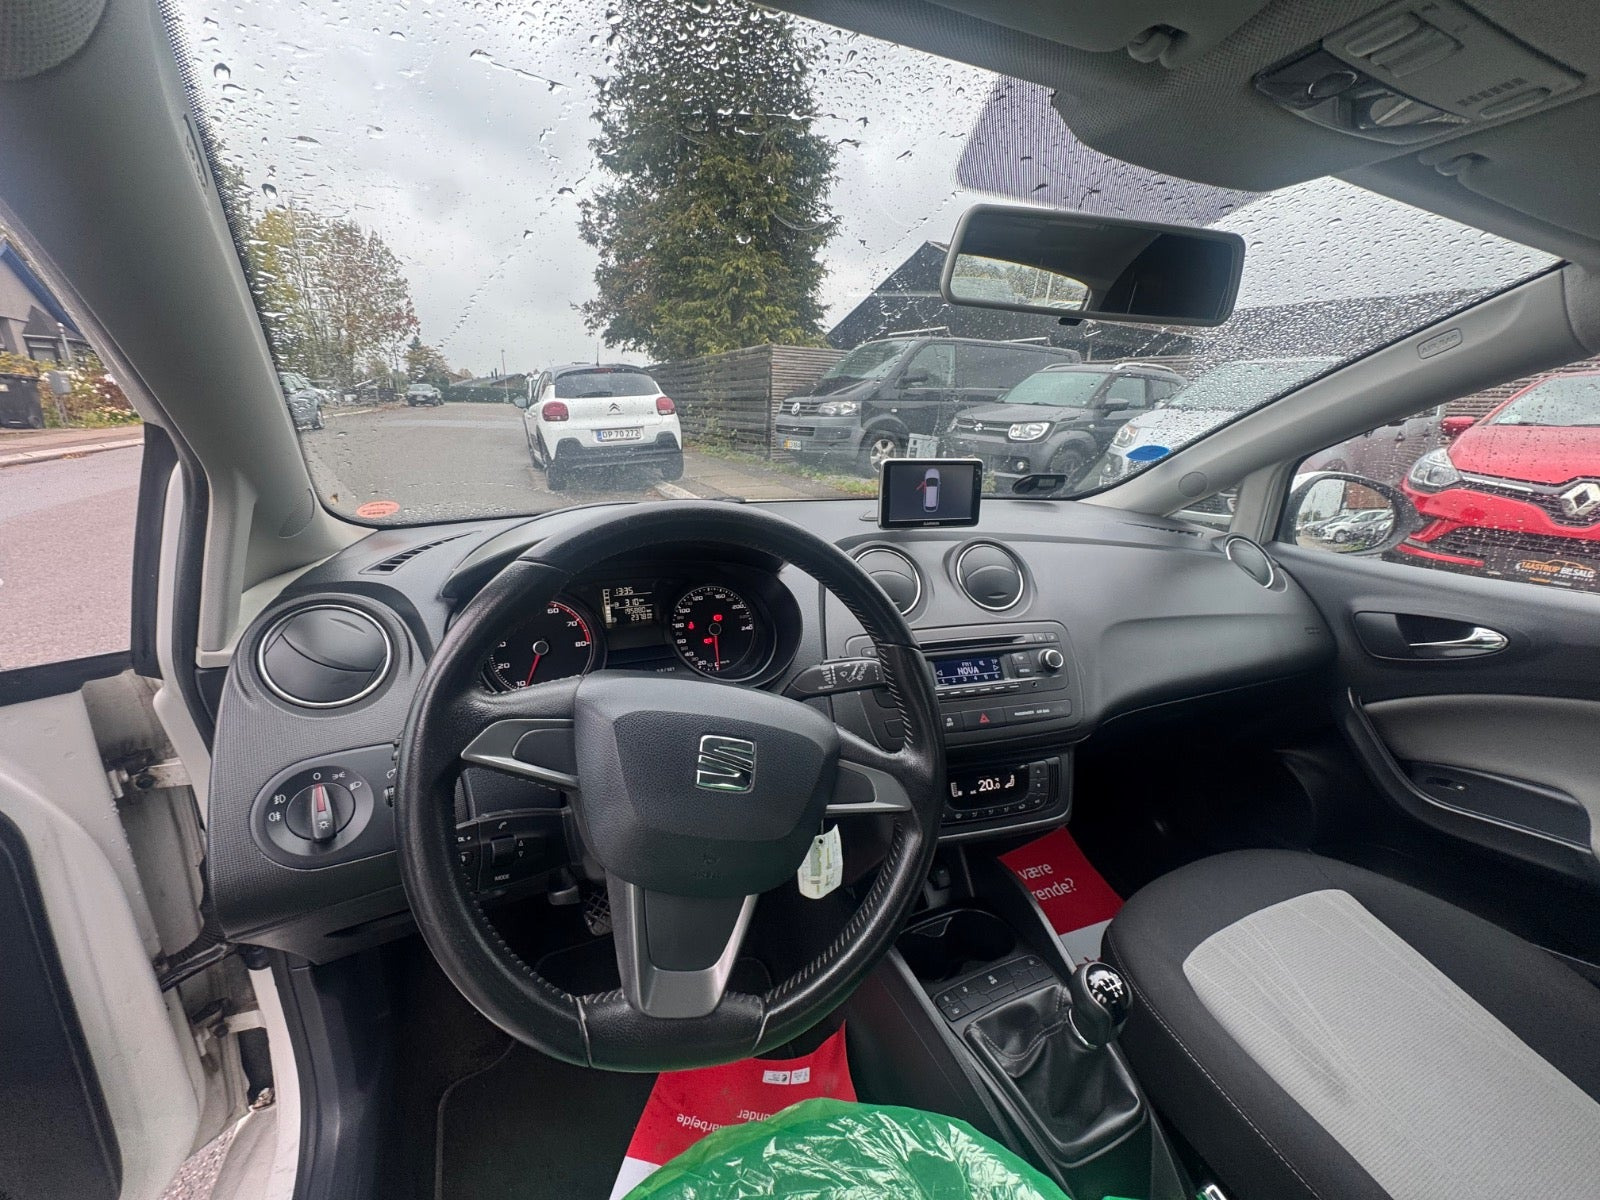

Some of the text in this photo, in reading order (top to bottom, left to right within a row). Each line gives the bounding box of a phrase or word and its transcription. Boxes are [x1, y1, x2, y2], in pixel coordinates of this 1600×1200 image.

[957, 666, 980, 675] NOVA
[1017, 863, 1054, 880] være
[676, 1113, 721, 1133] arbejde
